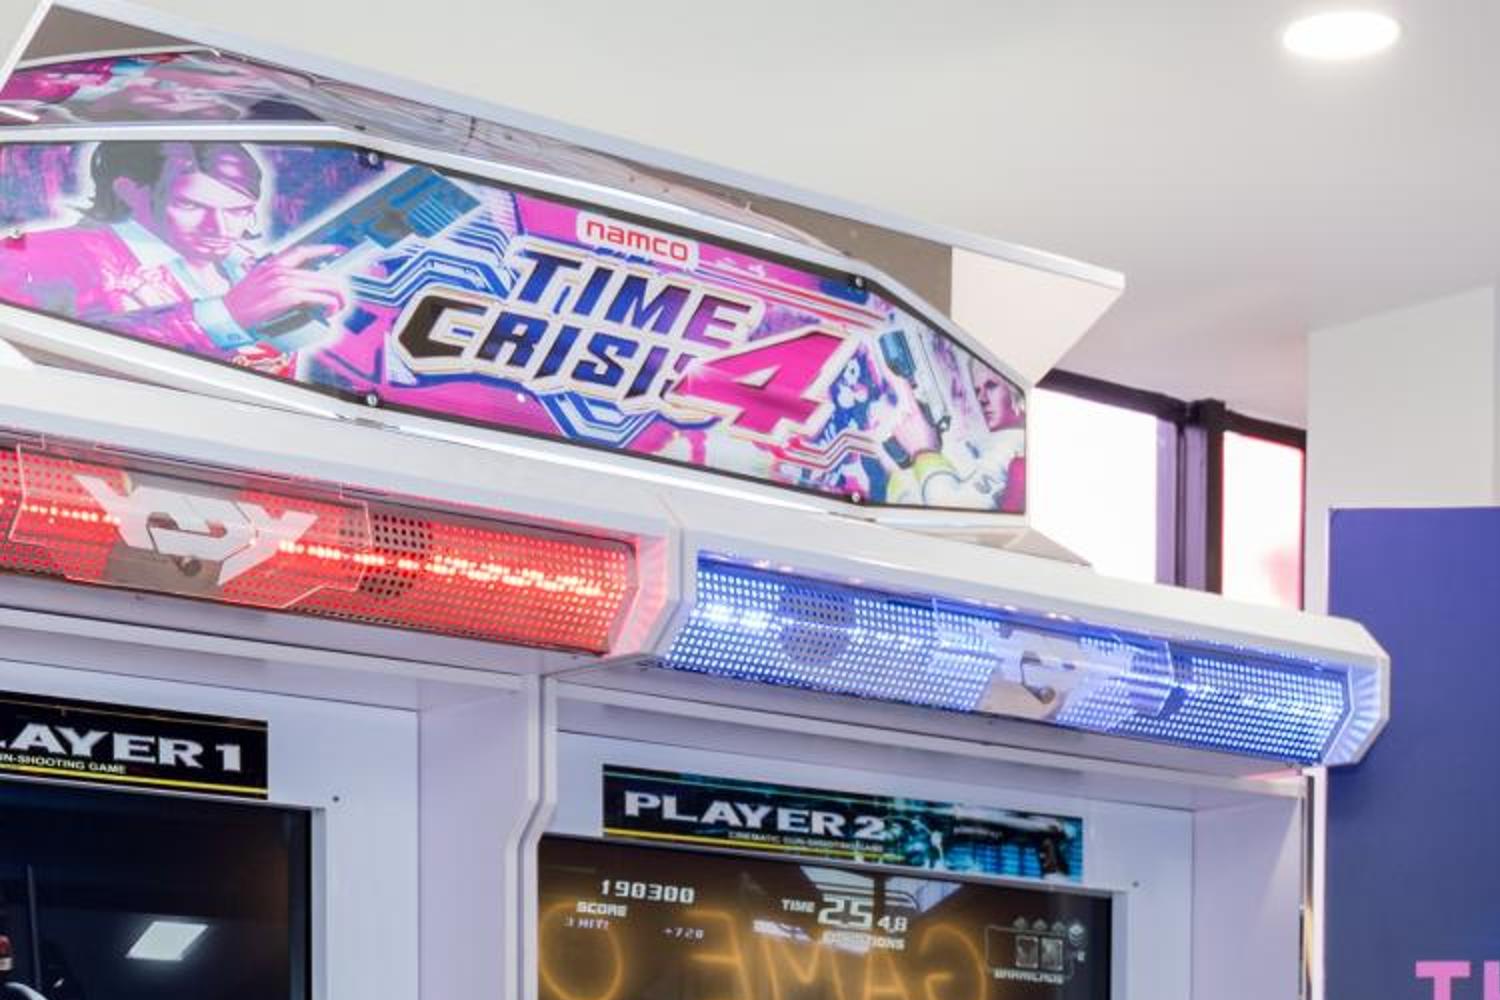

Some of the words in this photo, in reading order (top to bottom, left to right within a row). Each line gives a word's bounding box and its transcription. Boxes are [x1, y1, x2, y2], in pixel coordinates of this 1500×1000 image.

[586, 219, 690, 262] namco
[517, 248, 752, 350] TIME
[667, 330, 850, 435] 4
[0, 722, 204, 769] AYER
[215, 743, 242, 772] 1
[89, 762, 127, 775] GAME
[624, 790, 847, 837] PLAYER
[854, 815, 885, 842] 2
[576, 901, 629, 918] SCORE
[601, 879, 696, 905] 190300
[781, 898, 816, 913] TIME
[817, 893, 874, 929] 25
